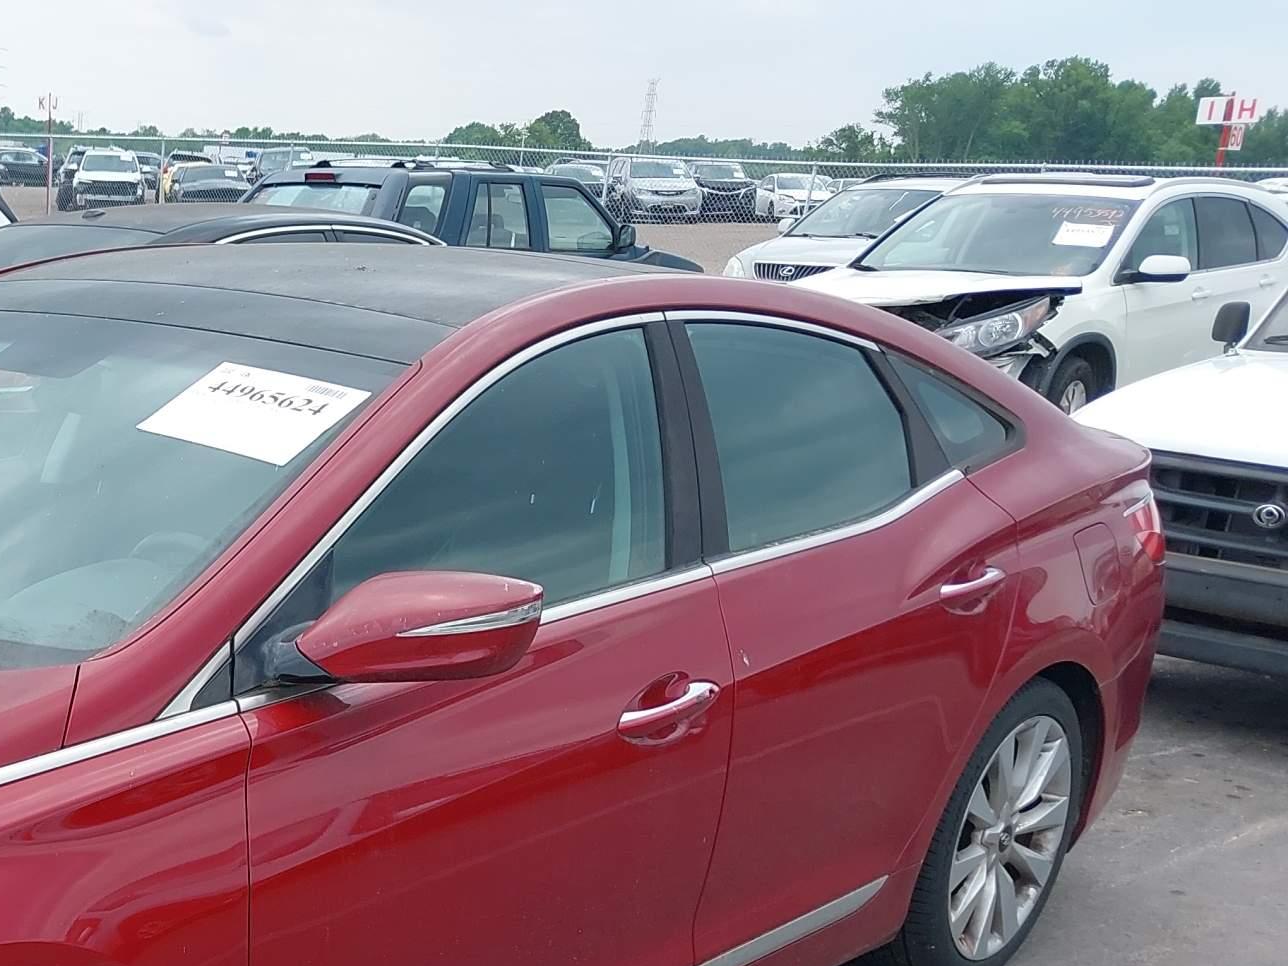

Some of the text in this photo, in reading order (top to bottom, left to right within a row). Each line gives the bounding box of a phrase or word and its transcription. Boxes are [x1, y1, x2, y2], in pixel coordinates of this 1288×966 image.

[38, 96, 46, 110] K
[1237, 98, 1258, 120] H
[1229, 125, 1243, 147] 60
[207, 380, 331, 416] 44965624
